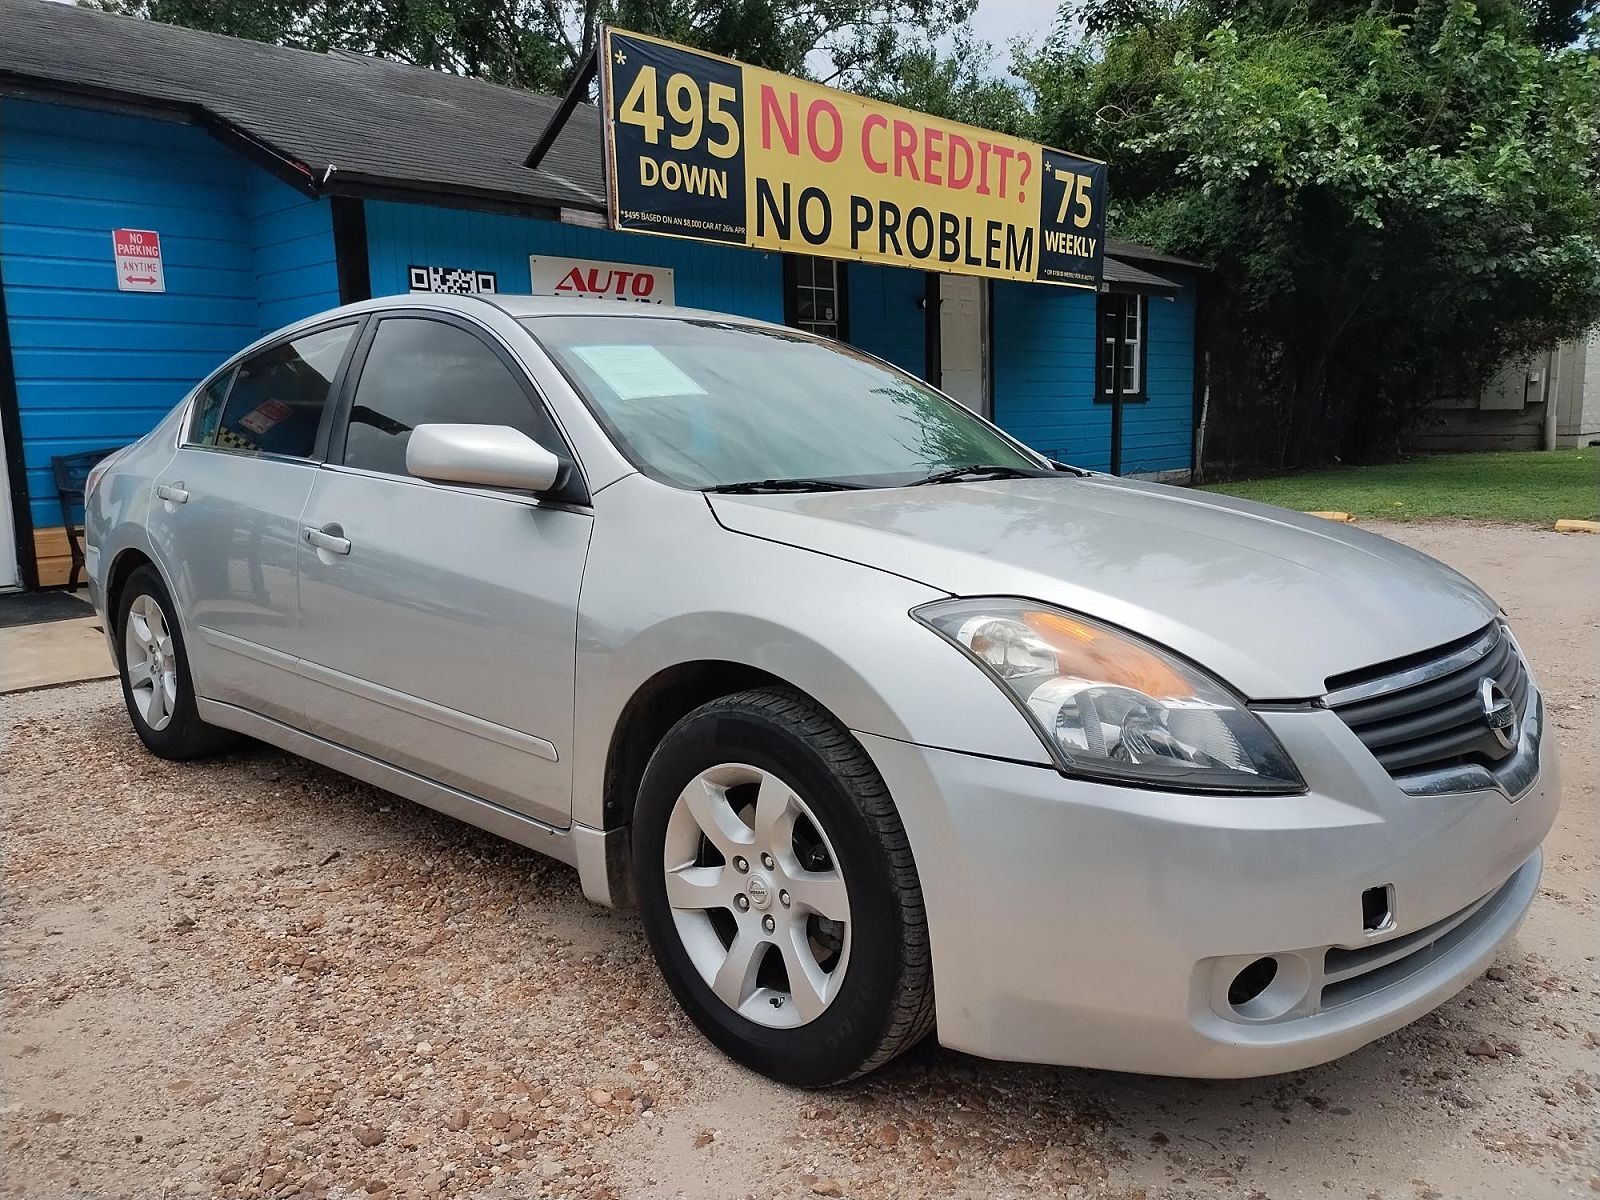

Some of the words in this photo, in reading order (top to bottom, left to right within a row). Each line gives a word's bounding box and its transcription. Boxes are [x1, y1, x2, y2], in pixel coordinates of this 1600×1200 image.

[760, 84, 843, 163] NO
[861, 113, 1032, 203] CREDIT?
[639, 155, 728, 199] DOWN
[640, 212, 661, 223] BASED
[662, 215, 673, 225] ON
[673, 217, 683, 226] AN
[683, 218, 702, 229] $8,000
[702, 221, 714, 230] CAR
[714, 223, 722, 232] AT
[734, 226, 746, 235] APR
[756, 177, 832, 245] NO
[850, 195, 1034, 273] PROBLEM
[117, 244, 158, 256] PARKING
[130, 233, 143, 244] NO
[1044, 230, 1096, 258] WEEKLY
[123, 261, 158, 273] ANYTIME
[554, 266, 655, 296] AUTO
